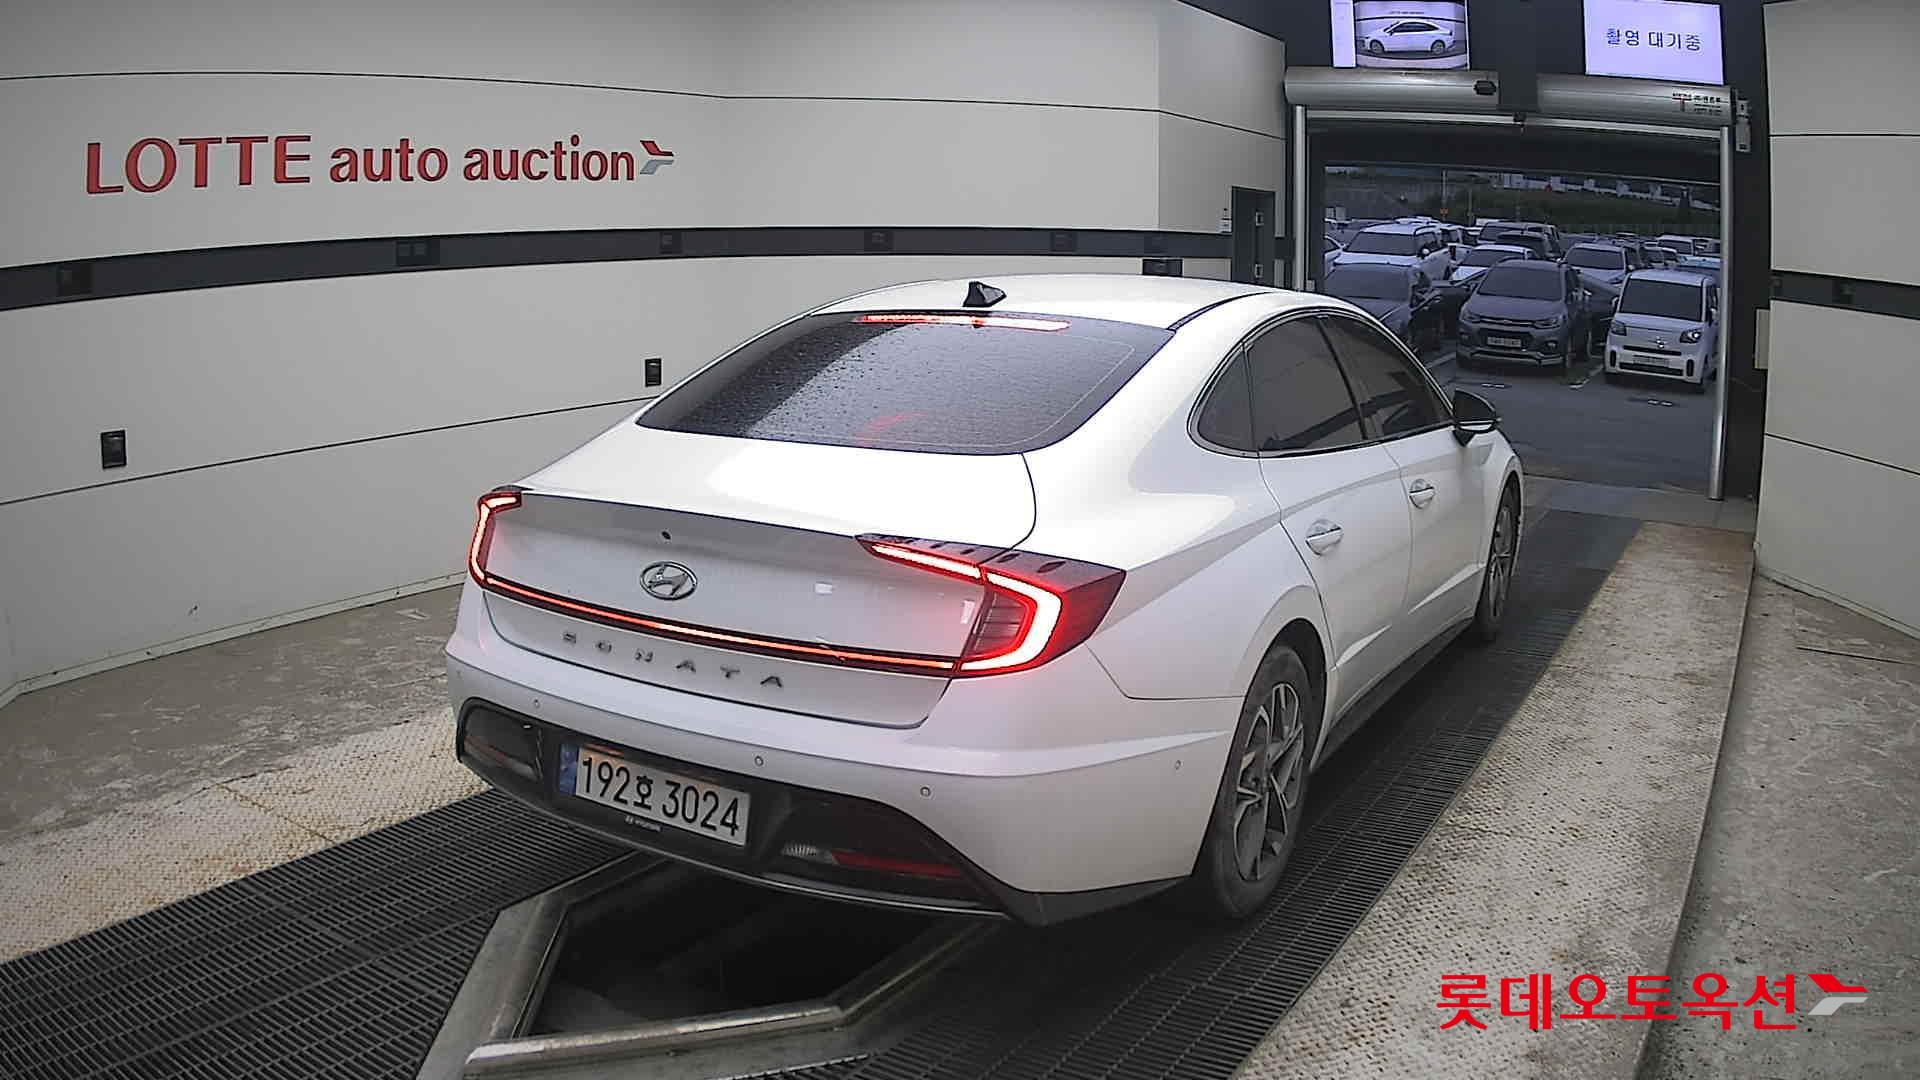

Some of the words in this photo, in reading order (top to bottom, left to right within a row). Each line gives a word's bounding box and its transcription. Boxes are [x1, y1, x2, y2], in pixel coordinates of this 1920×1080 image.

[1648, 31, 1701, 51] 대기중
[86, 134, 311, 194] LOTTE
[329, 138, 448, 183] auto
[463, 134, 635, 182] auction
[582, 756, 654, 811] 192호
[661, 779, 740, 837] 3024
